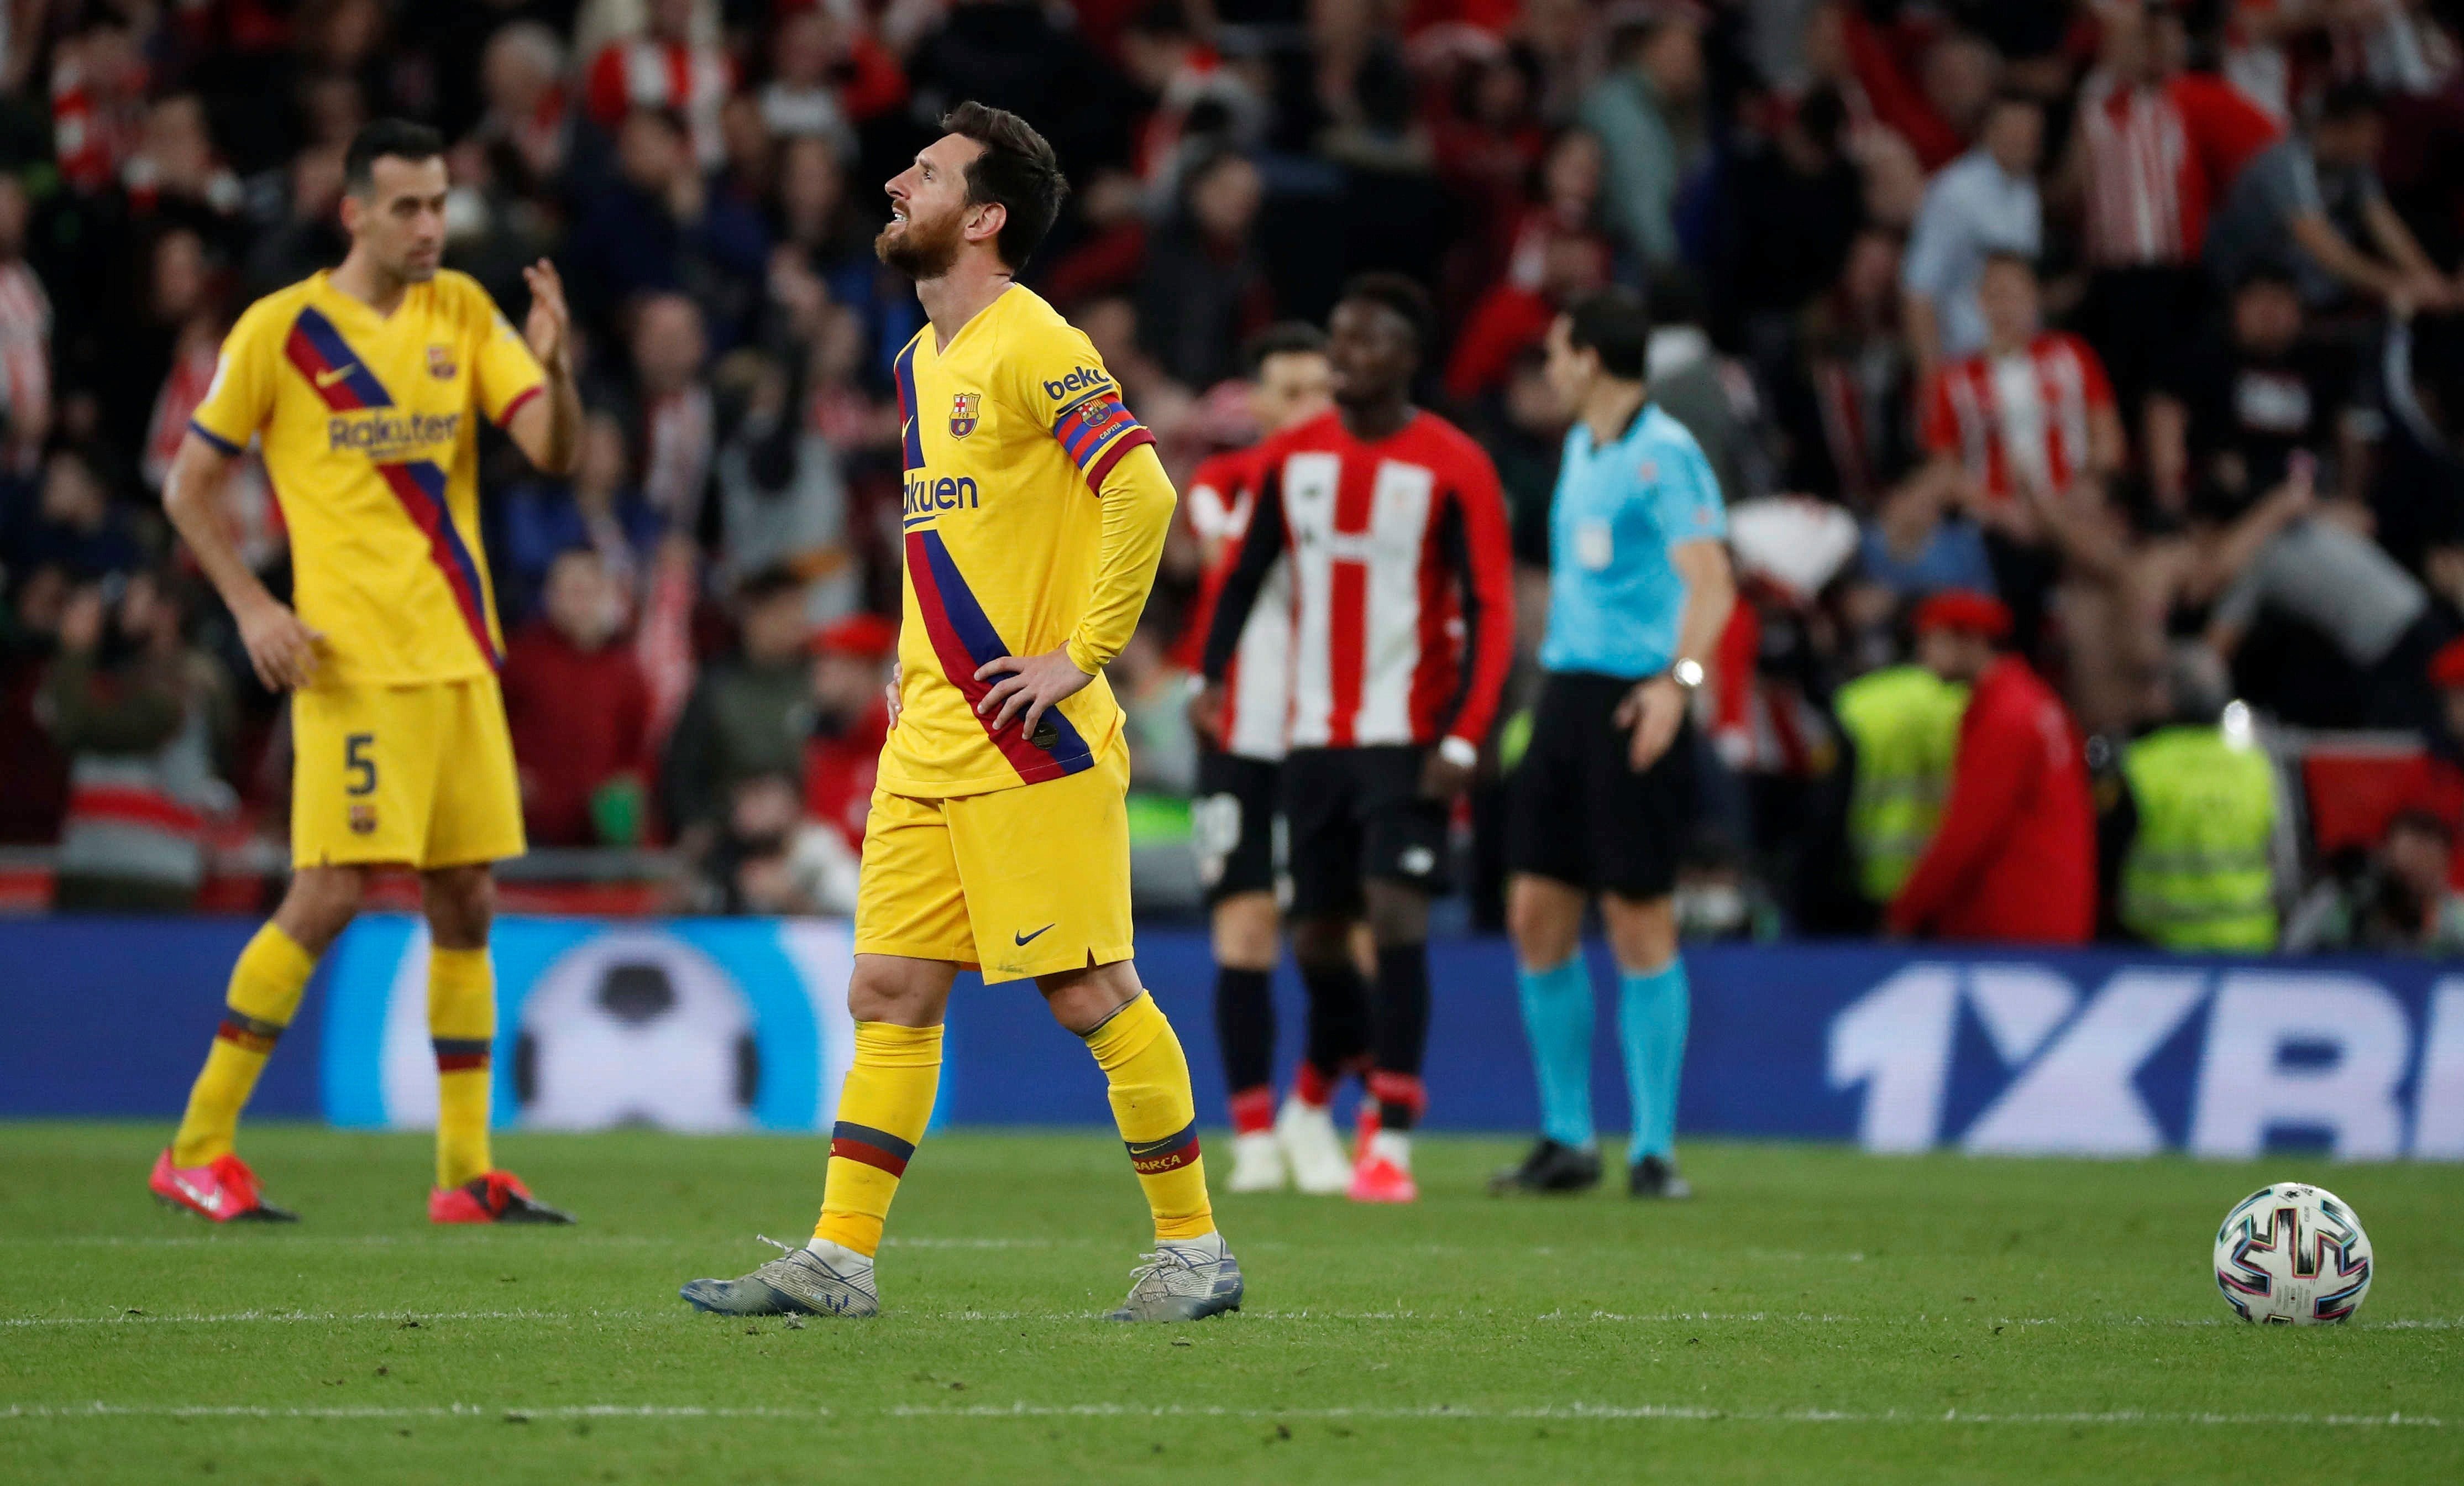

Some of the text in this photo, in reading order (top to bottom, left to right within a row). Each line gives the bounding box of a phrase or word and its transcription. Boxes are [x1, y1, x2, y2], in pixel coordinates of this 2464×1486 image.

[345, 734, 376, 795] 5
[1828, 960, 2464, 1159] 1XB
[1133, 1154, 1181, 1170] BARÇA
